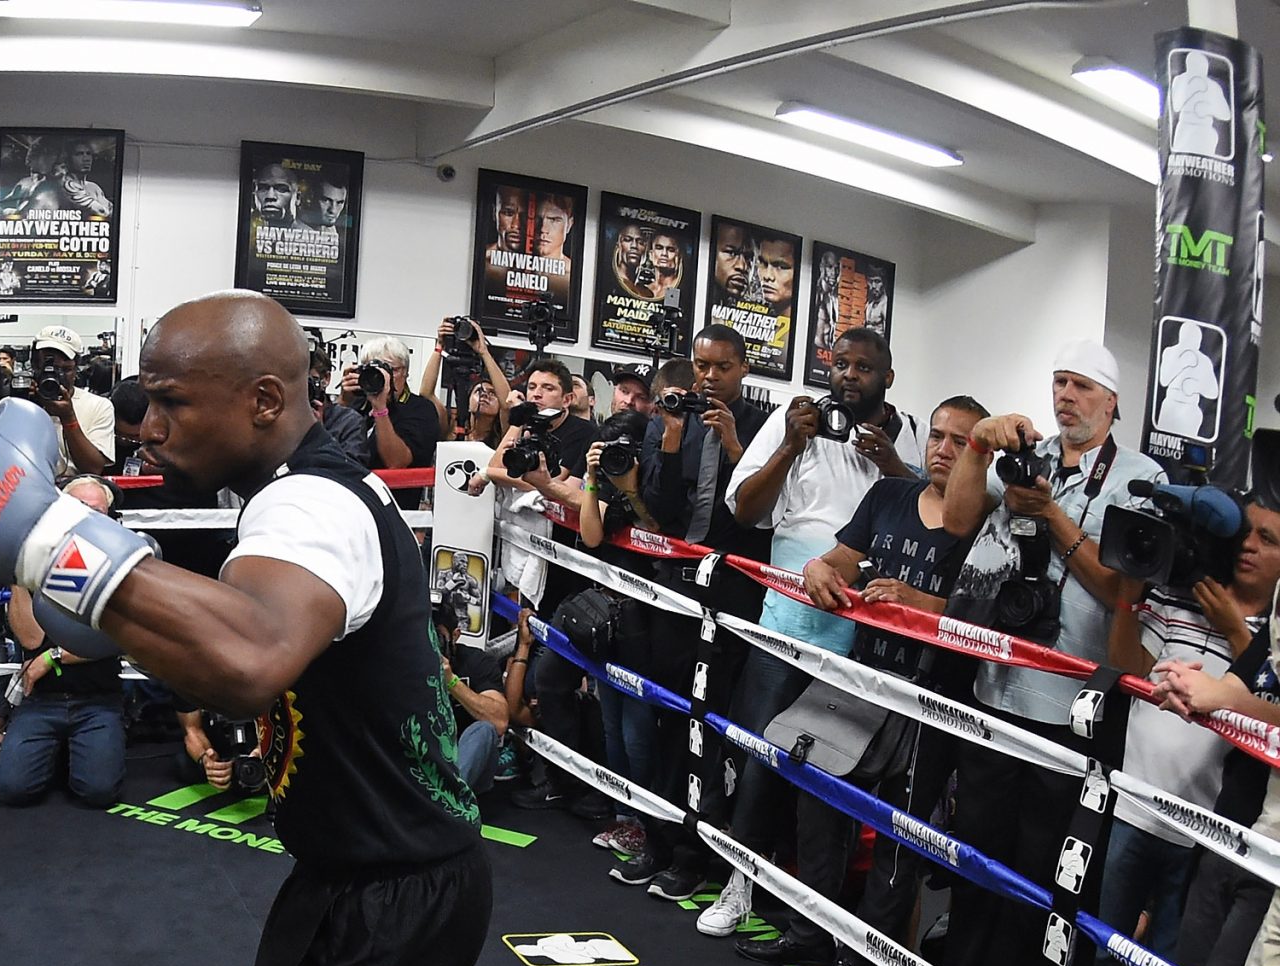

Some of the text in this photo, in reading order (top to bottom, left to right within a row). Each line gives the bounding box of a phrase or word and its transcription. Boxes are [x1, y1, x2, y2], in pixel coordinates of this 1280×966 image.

[1167, 154, 1234, 177] MAYWEATHER
[1167, 166, 1235, 186] PROMOTIONS
[29, 209, 82, 221] RING KINGS
[620, 207, 688, 231] MOMENT
[0, 220, 110, 237] MAYWEATHER
[256, 226, 339, 246] MAYWEATHER
[60, 237, 109, 253] COTTO
[256, 240, 339, 259] VS GUERRERO
[1166, 224, 1234, 266] TMT
[490, 249, 566, 276] MAYWEATHER
[506, 270, 548, 292] CANELO
[607, 294, 664, 314] MAYWEAT
[736, 301, 769, 315] MAYHEM
[602, 320, 642, 334] SATURDAY
[712, 304, 777, 330] MAYWEATHER
[732, 315, 791, 349] MAIDANA 2
[1094, 462, 1107, 480] EOS
[937, 616, 1001, 645] MAYWEATHER
[937, 630, 1000, 657] PROMOTIONS
[917, 693, 976, 725] MAYWEATHER
[920, 706, 982, 739] PROMOTIONS
[1153, 796, 1231, 835] MAYWEATHER
[1158, 804, 1237, 851] PROMOTIONS
[105, 803, 285, 855] THE MONE
[892, 809, 949, 849] MAYWEATHER
[893, 823, 950, 862] PROMOTIONS
